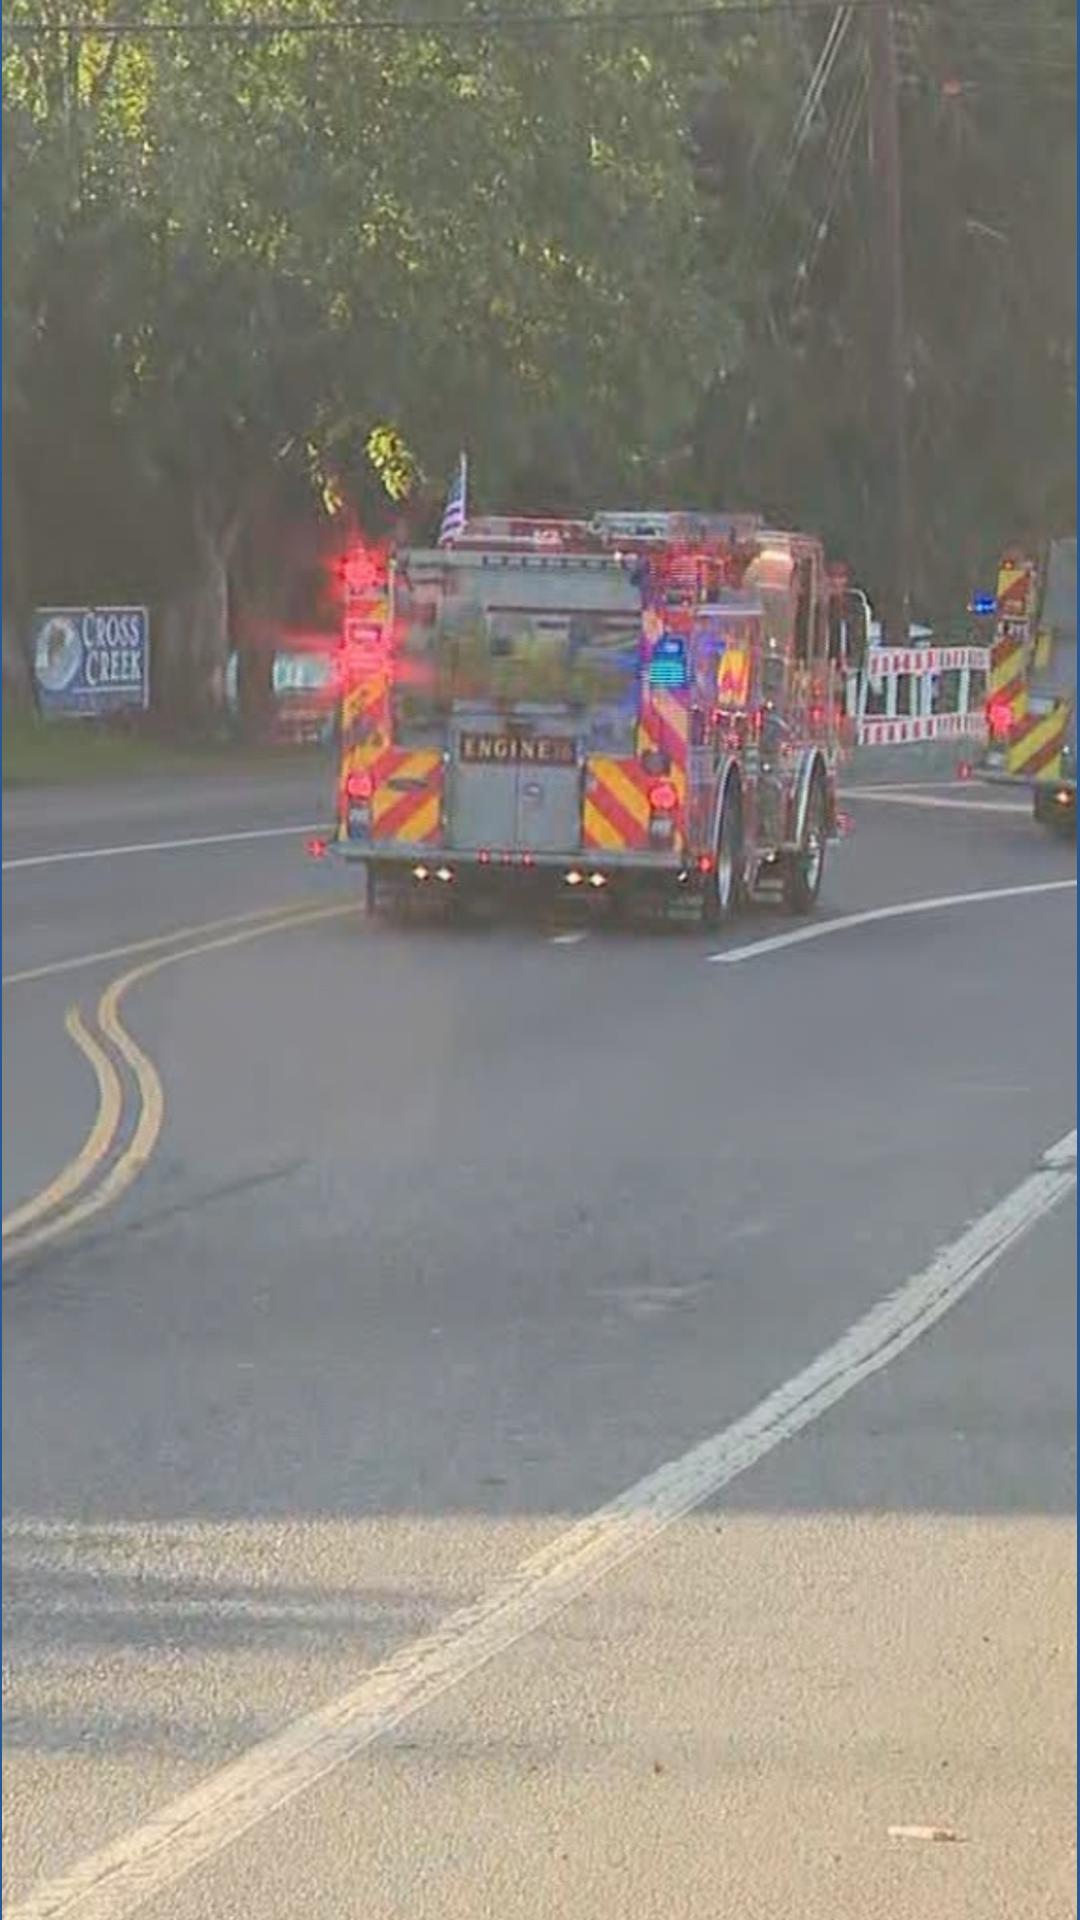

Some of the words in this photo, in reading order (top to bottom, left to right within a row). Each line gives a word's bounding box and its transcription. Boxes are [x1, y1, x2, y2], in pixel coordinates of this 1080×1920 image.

[83, 613, 140, 647] CROSS
[86, 651, 141, 684] CREEK
[465, 739, 552, 758] ENGINE
